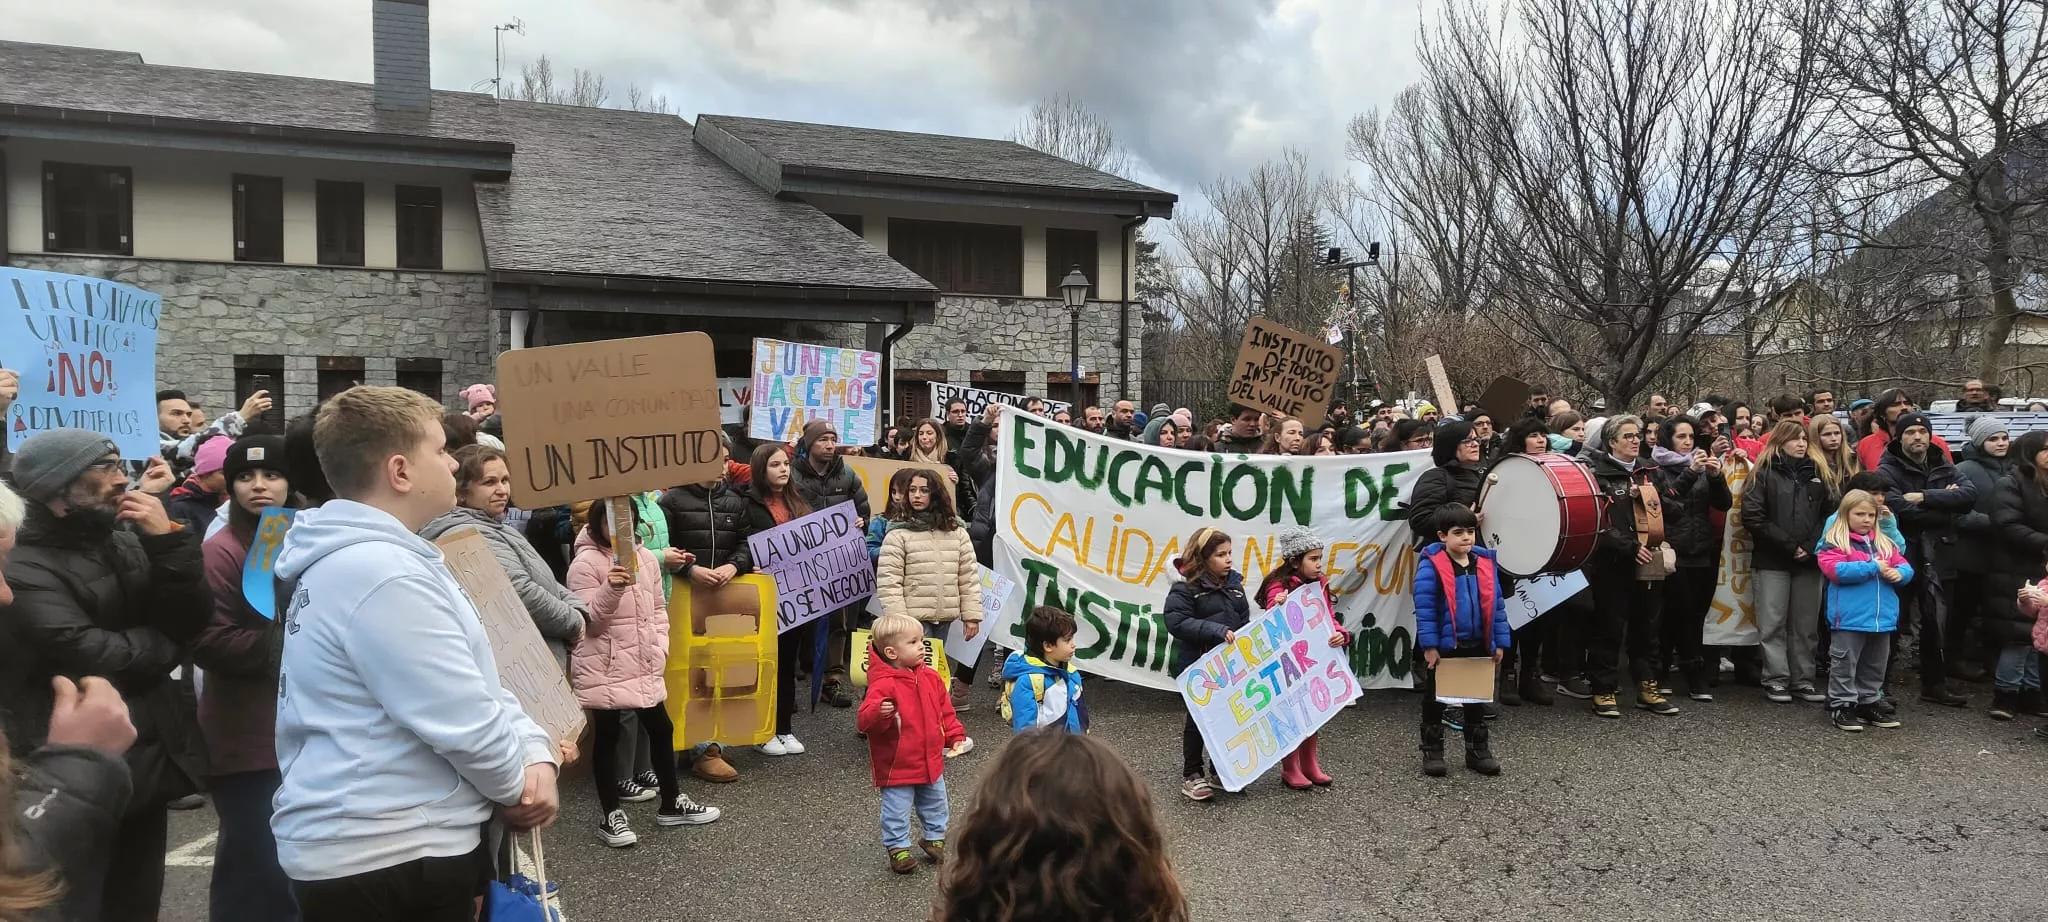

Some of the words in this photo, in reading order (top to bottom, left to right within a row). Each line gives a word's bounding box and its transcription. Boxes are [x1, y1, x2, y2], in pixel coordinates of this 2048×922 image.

[514, 359, 552, 387] UN
[566, 352, 651, 382] VALLE
[761, 340, 877, 379] JUNTOS
[1250, 326, 1334, 373] INSTITUTO
[47, 351, 112, 397] ¡NO!
[754, 374, 877, 411] HACEMOS
[1242, 362, 1325, 403] INSTITUTO
[553, 406, 594, 424] UNA
[1043, 400, 1061, 413] DE
[1230, 381, 1255, 400] DEL
[1259, 390, 1304, 415] VALLE
[525, 443, 575, 492] UN
[585, 429, 721, 481] INSTITUTO
[1344, 462, 1411, 521] DE
[753, 538, 783, 569] LA
[782, 512, 849, 556] UNIDAD
[797, 536, 869, 589] INSTITUTO
[1242, 533, 1284, 585] N
[796, 589, 820, 617] SE
[820, 569, 878, 609] NEGOCIA
[1186, 586, 1326, 708] QUEREMOS
[1228, 639, 1318, 727] ESTAR
[1226, 660, 1353, 777] JUNTOS
